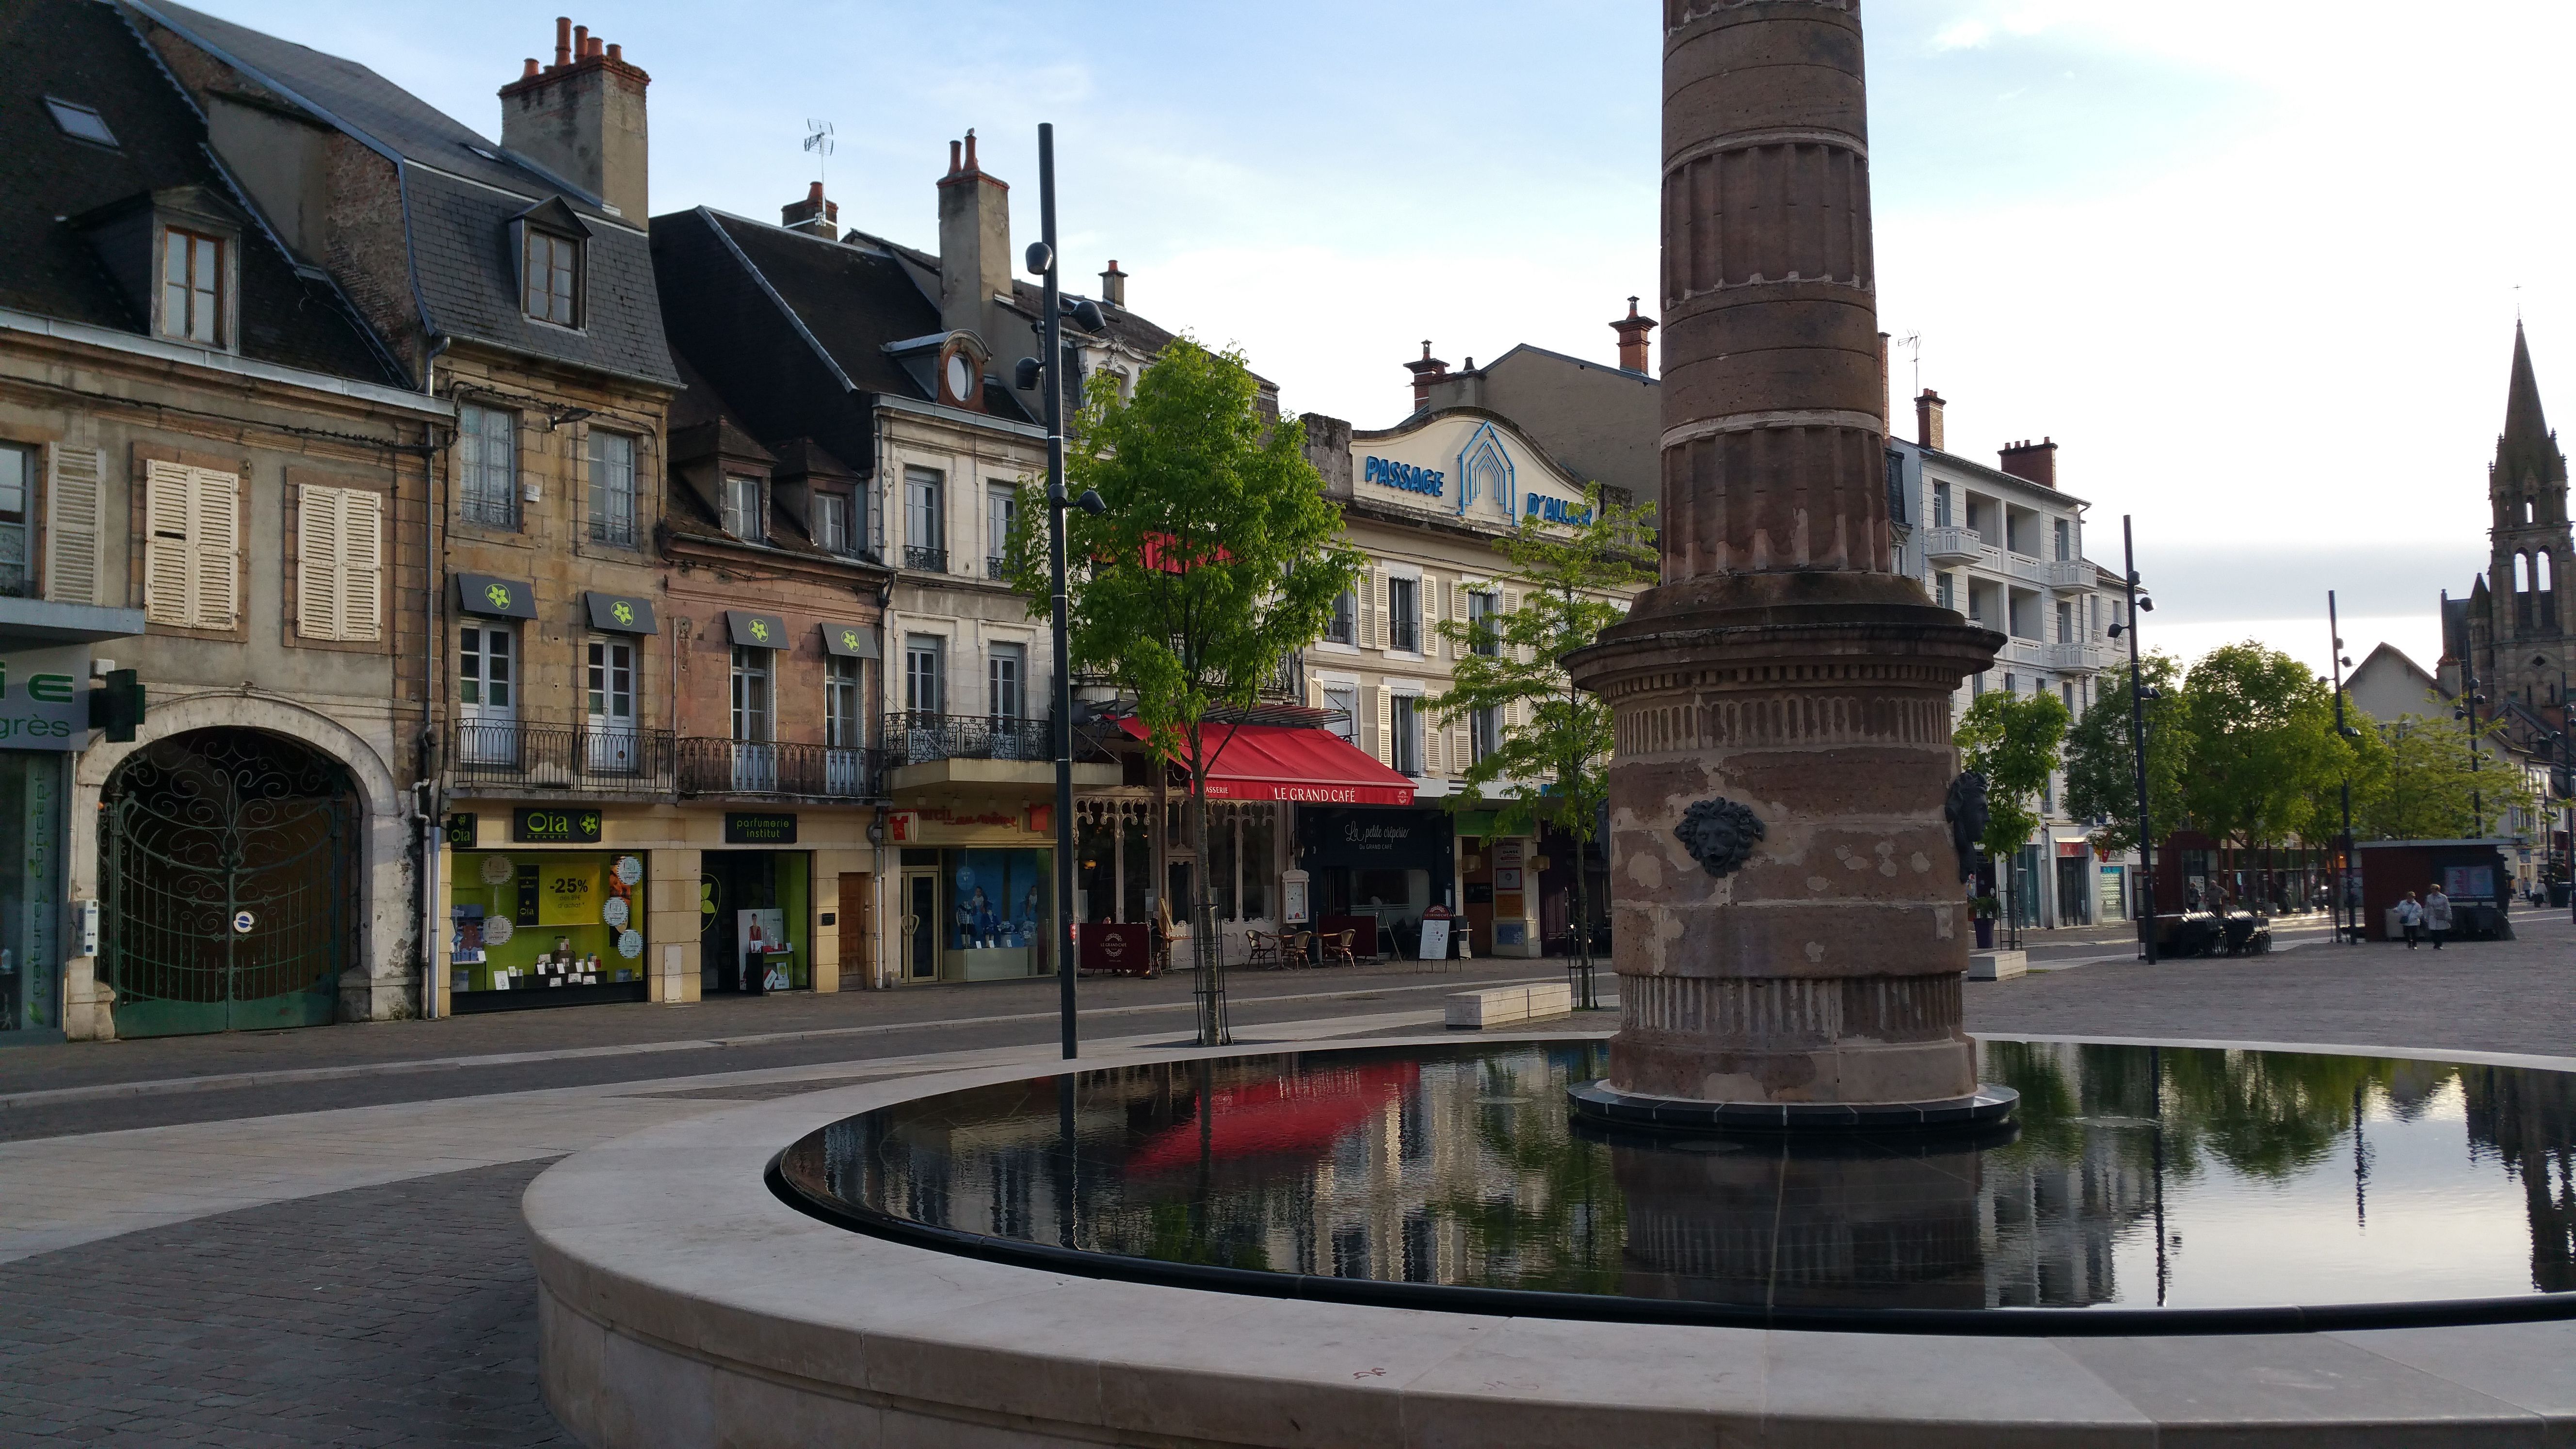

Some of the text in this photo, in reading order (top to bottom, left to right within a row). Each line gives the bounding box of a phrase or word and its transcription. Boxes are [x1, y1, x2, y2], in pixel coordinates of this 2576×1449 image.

[1365, 456, 1444, 497] PASSAGE
[1274, 787, 1355, 802] LE GRAND CAFÉ
[34, 770, 47, 880] concept
[527, 811, 569, 832] Oïa
[737, 818, 789, 830] parfumerie
[451, 828, 471, 842] Oïa
[746, 829, 780, 838] institut
[1345, 821, 1410, 843] La petite crêperie
[549, 878, 588, 893] -25%
